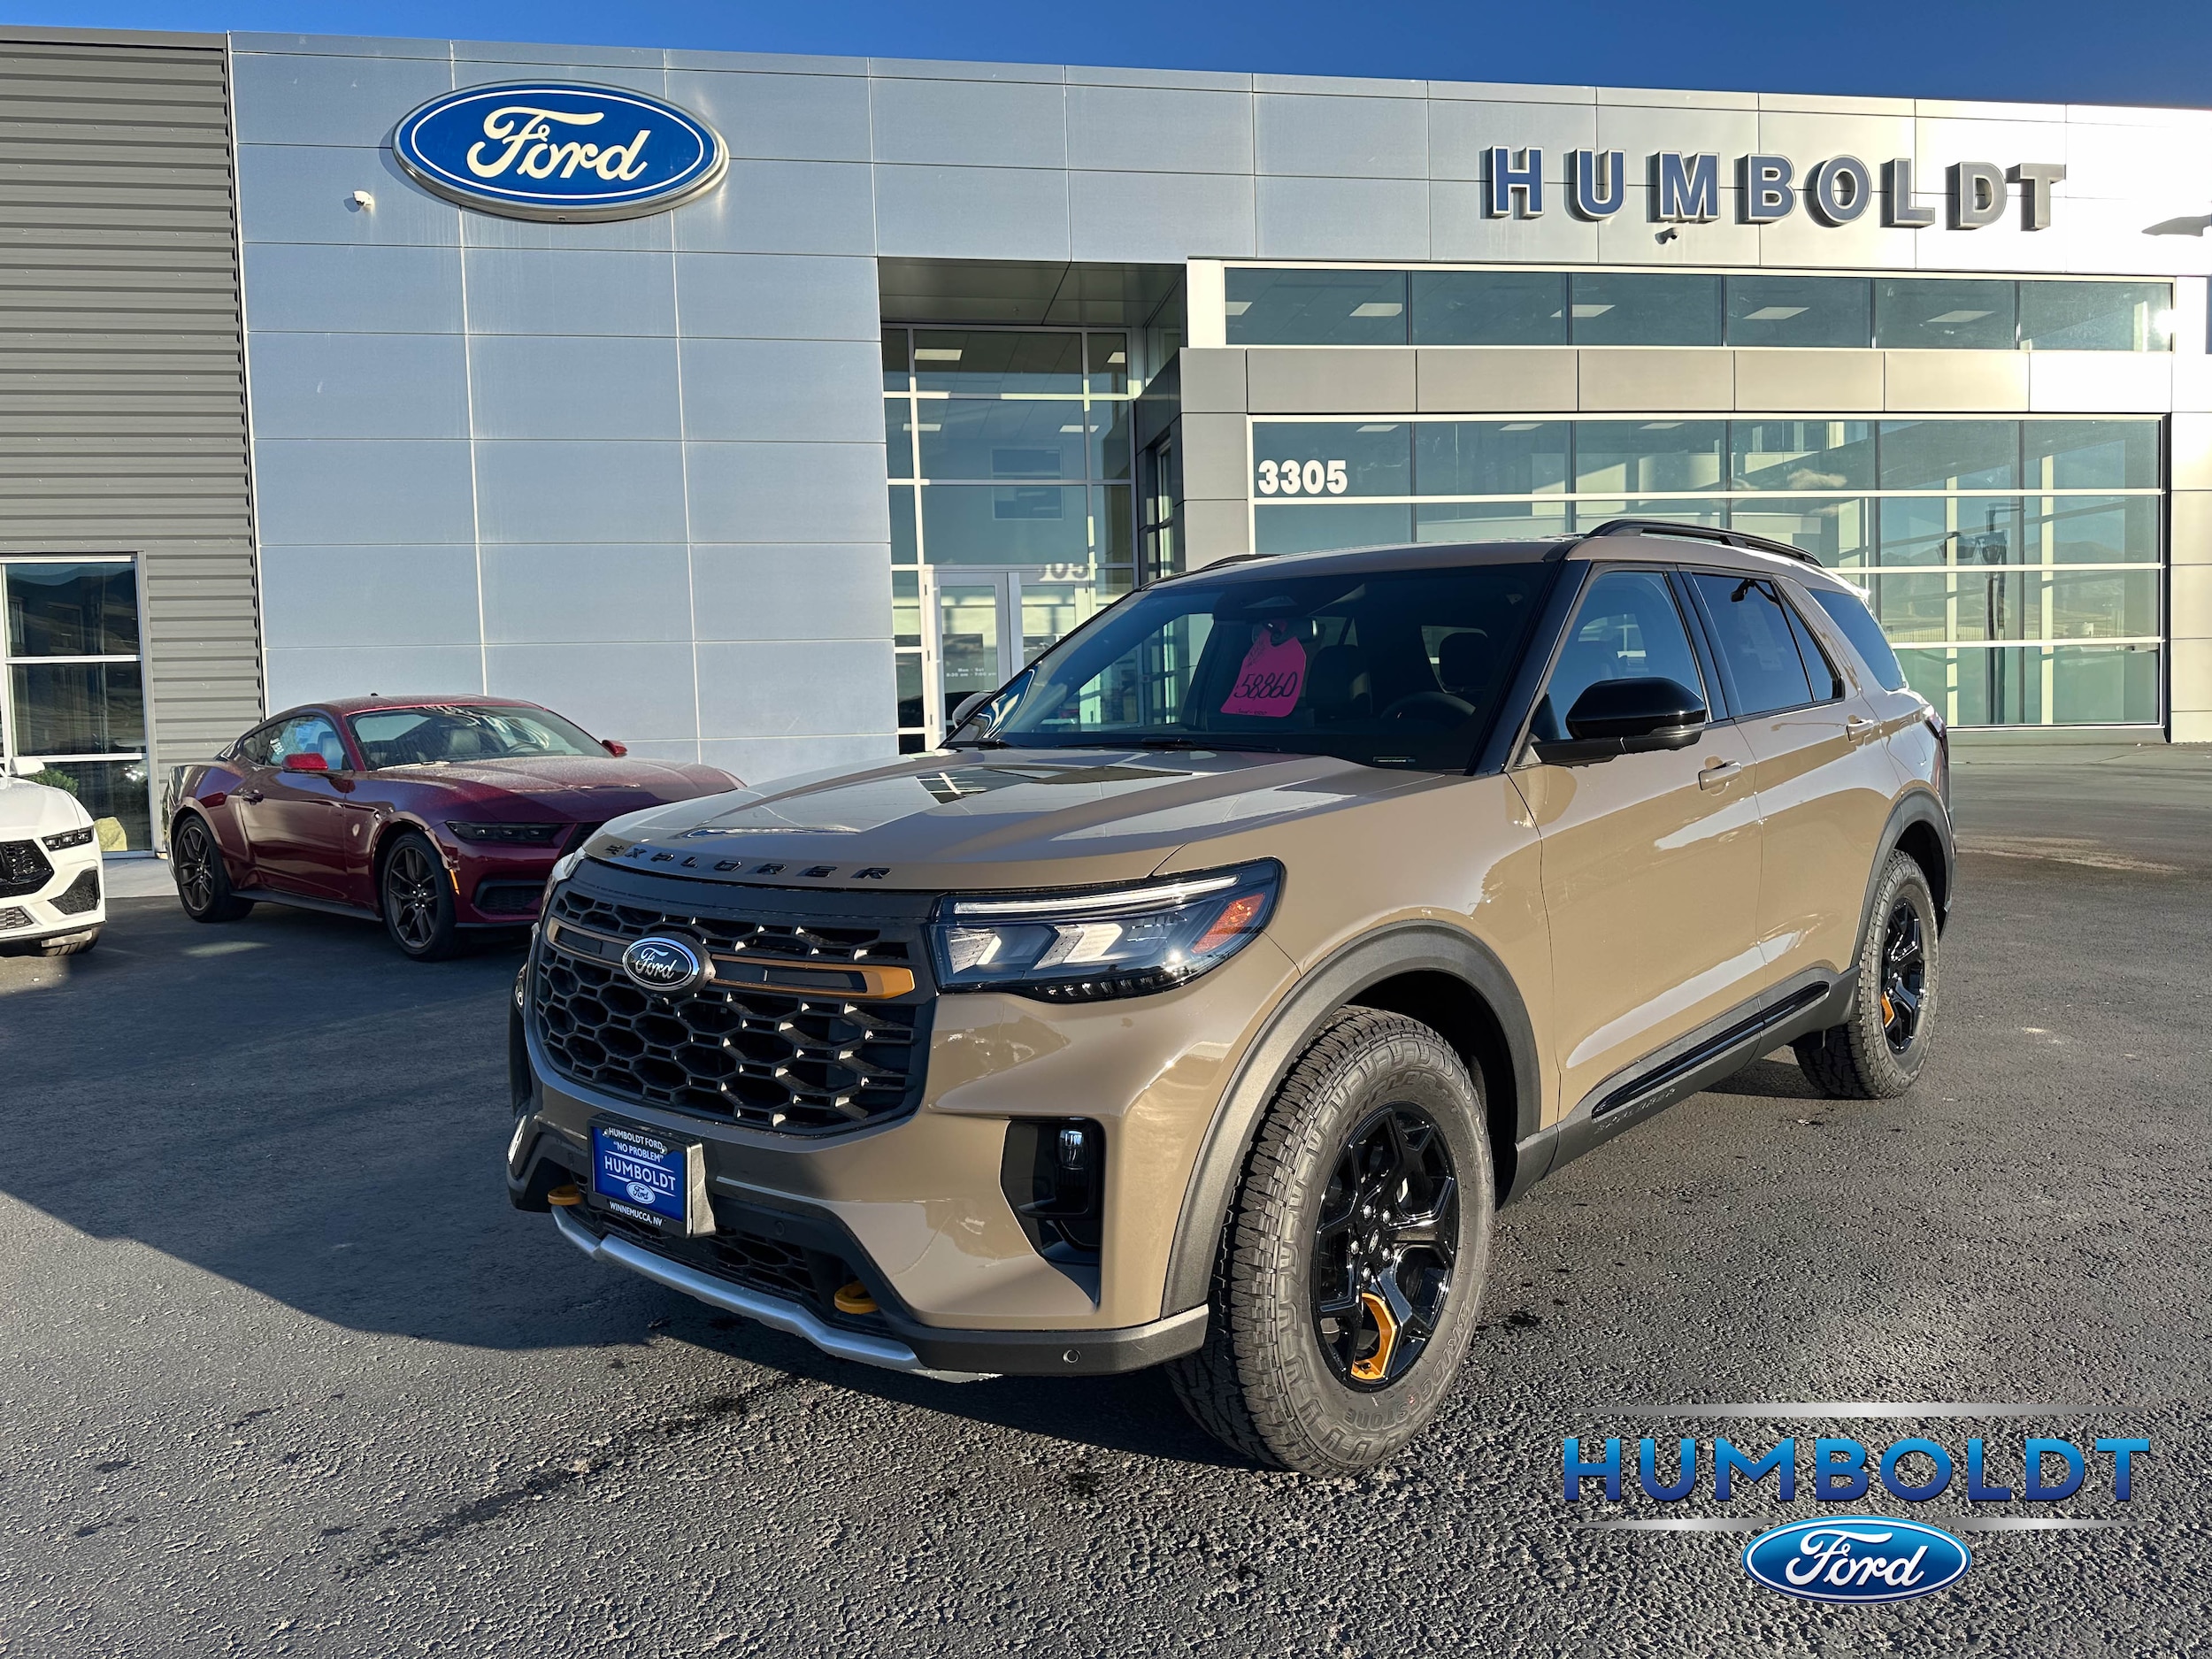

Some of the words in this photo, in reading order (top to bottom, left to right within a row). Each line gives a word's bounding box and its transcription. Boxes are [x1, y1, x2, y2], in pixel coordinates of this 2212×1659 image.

[466, 105, 651, 181] Ford
[1481, 144, 2067, 231] HUMBOLDT
[1257, 459, 1348, 495] 3305
[603, 843, 893, 880] EXPLORER
[634, 946, 679, 979] Ford
[609, 1126, 645, 1145] HUMBOLDT
[644, 1137, 663, 1150] FORD
[603, 1155, 677, 1191] HUMBOLDT
[632, 1186, 649, 1201] Ford
[652, 1217, 663, 1227] NV
[1344, 1300, 1471, 1431] BRIDGESTONE
